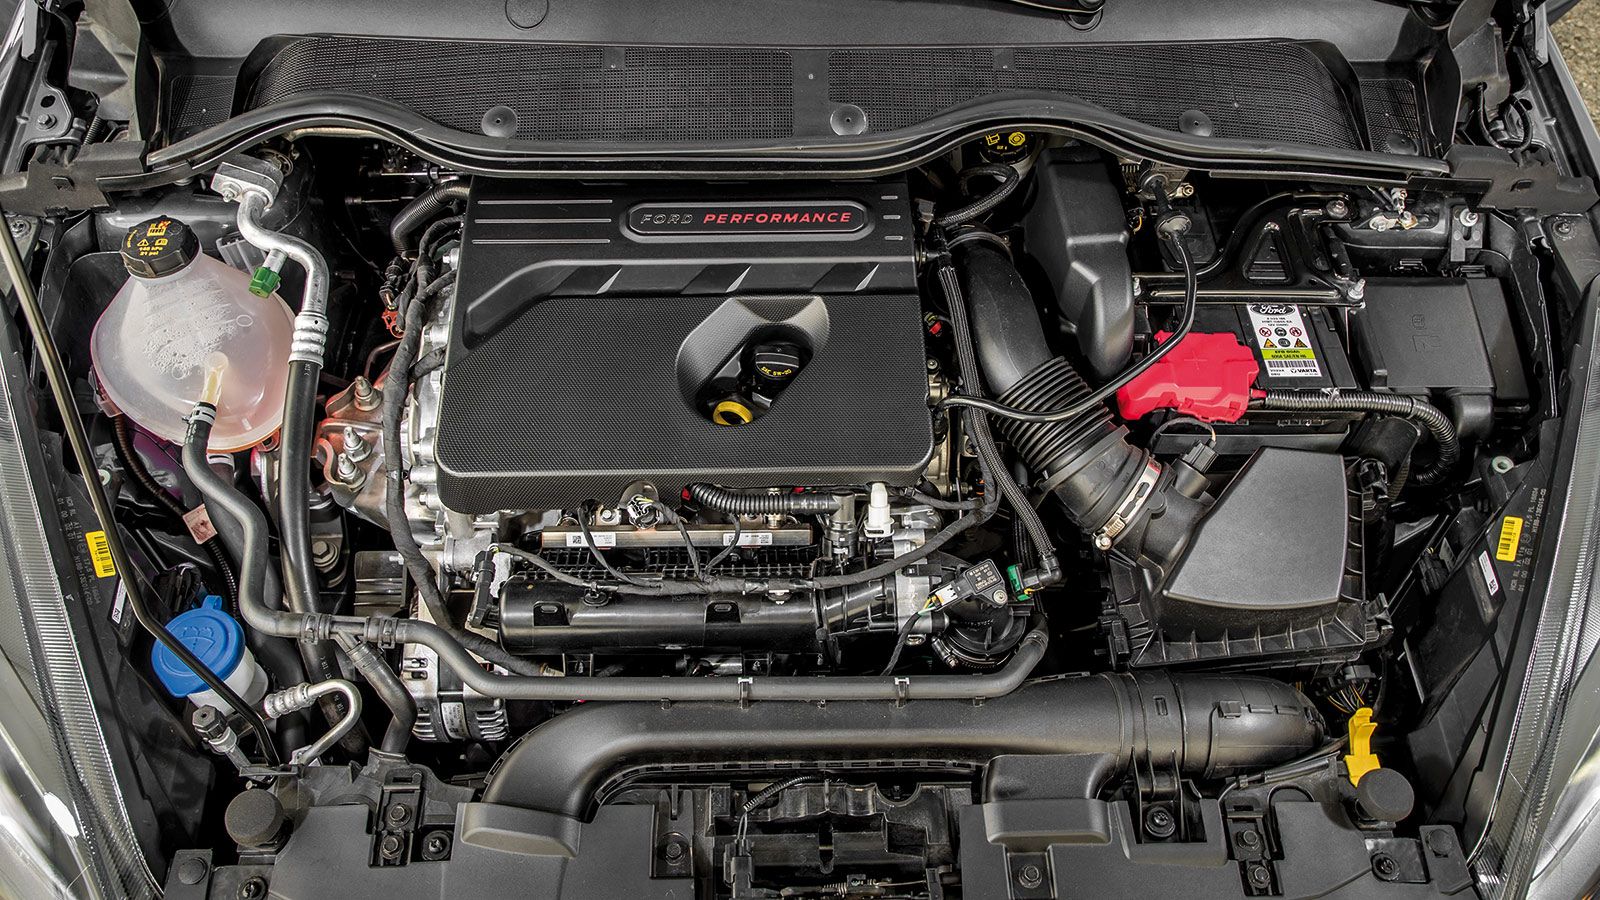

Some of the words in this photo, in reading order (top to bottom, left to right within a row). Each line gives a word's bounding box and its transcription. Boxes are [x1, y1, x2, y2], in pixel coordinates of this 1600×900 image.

[640, 213, 694, 225] FORD
[703, 212, 852, 224] PERFORMANCE
[1259, 303, 1287, 314] Ford
